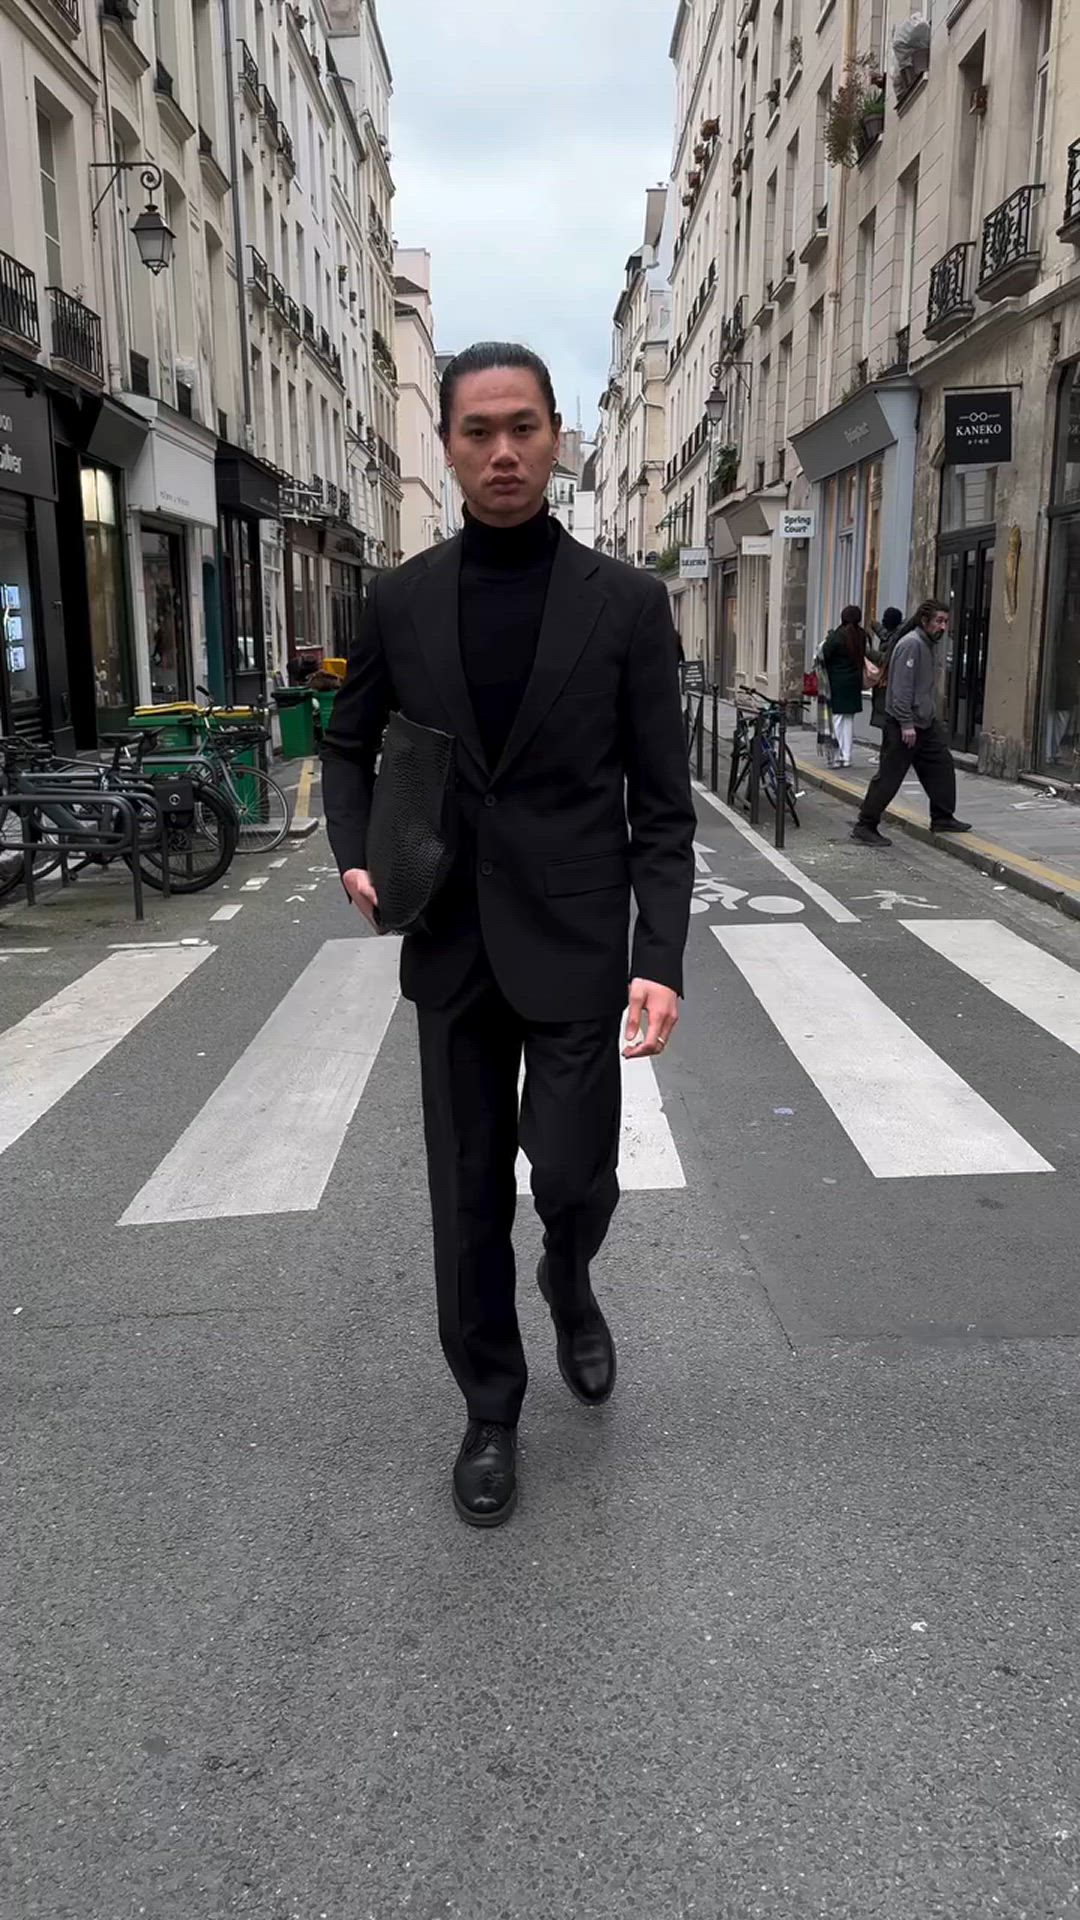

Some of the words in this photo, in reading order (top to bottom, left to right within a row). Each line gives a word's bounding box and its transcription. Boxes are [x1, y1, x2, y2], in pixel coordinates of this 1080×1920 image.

[956, 424, 1002, 436] KANEKO
[784, 515, 811, 526] Spring
[784, 525, 808, 533] Court
